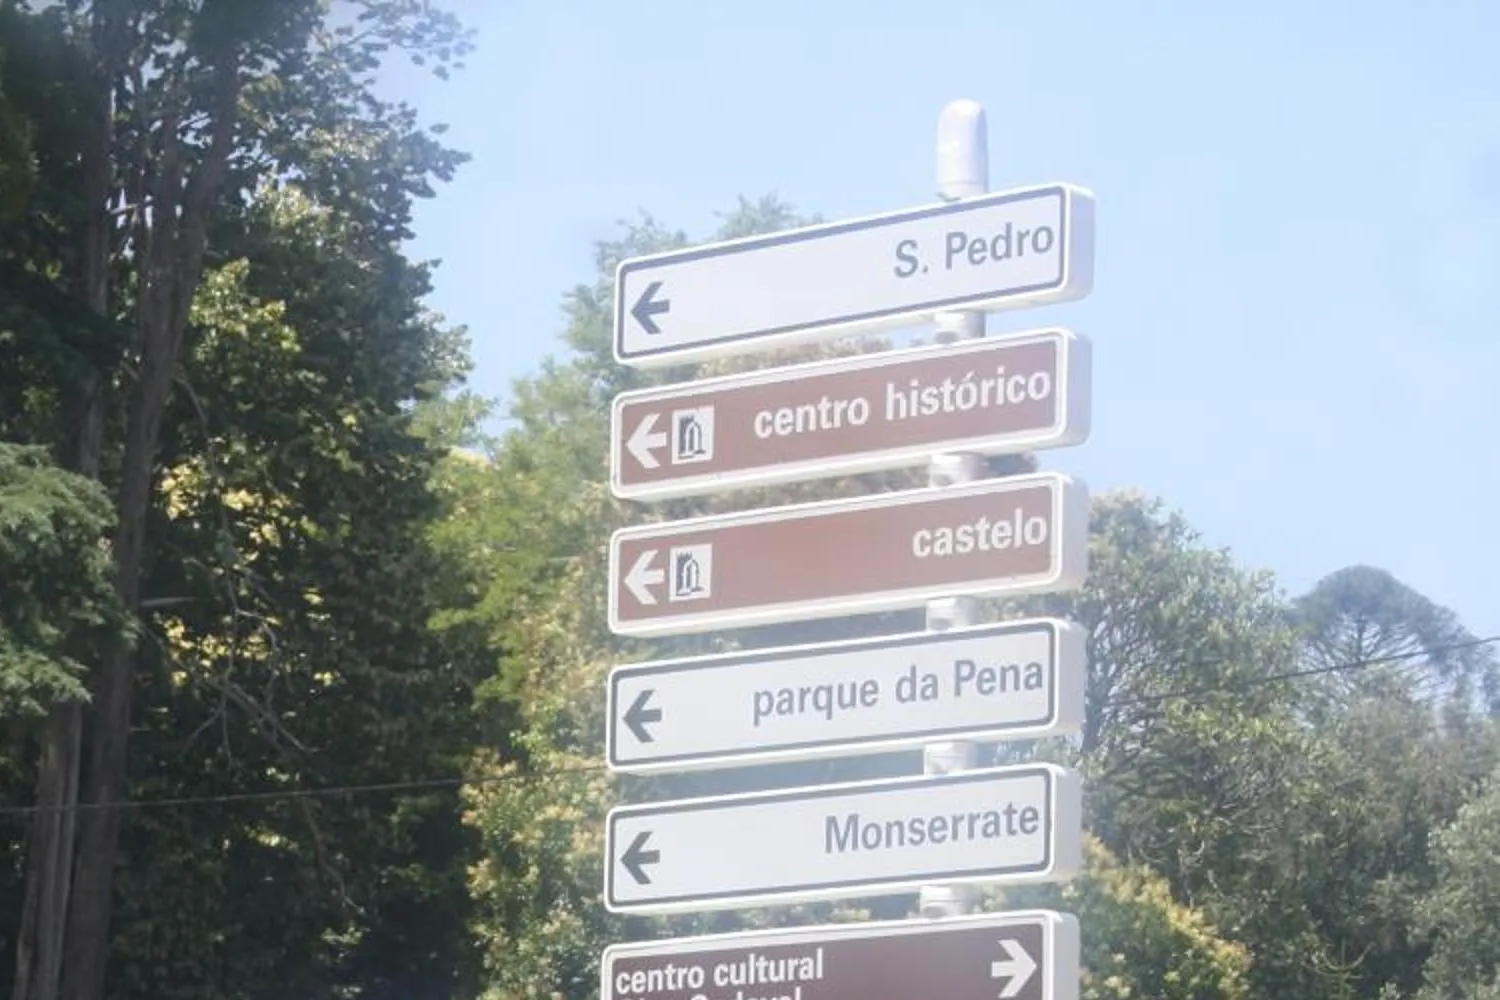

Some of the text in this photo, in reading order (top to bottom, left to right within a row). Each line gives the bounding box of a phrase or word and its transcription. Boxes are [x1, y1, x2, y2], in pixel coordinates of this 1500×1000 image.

[893, 222, 1054, 278] S. Pedro
[754, 367, 1051, 439] centro histórico
[913, 508, 1047, 557] castelo
[753, 659, 1044, 726] parque da Pena
[825, 802, 1040, 854] Monserrate
[615, 948, 824, 994] centro cultural
